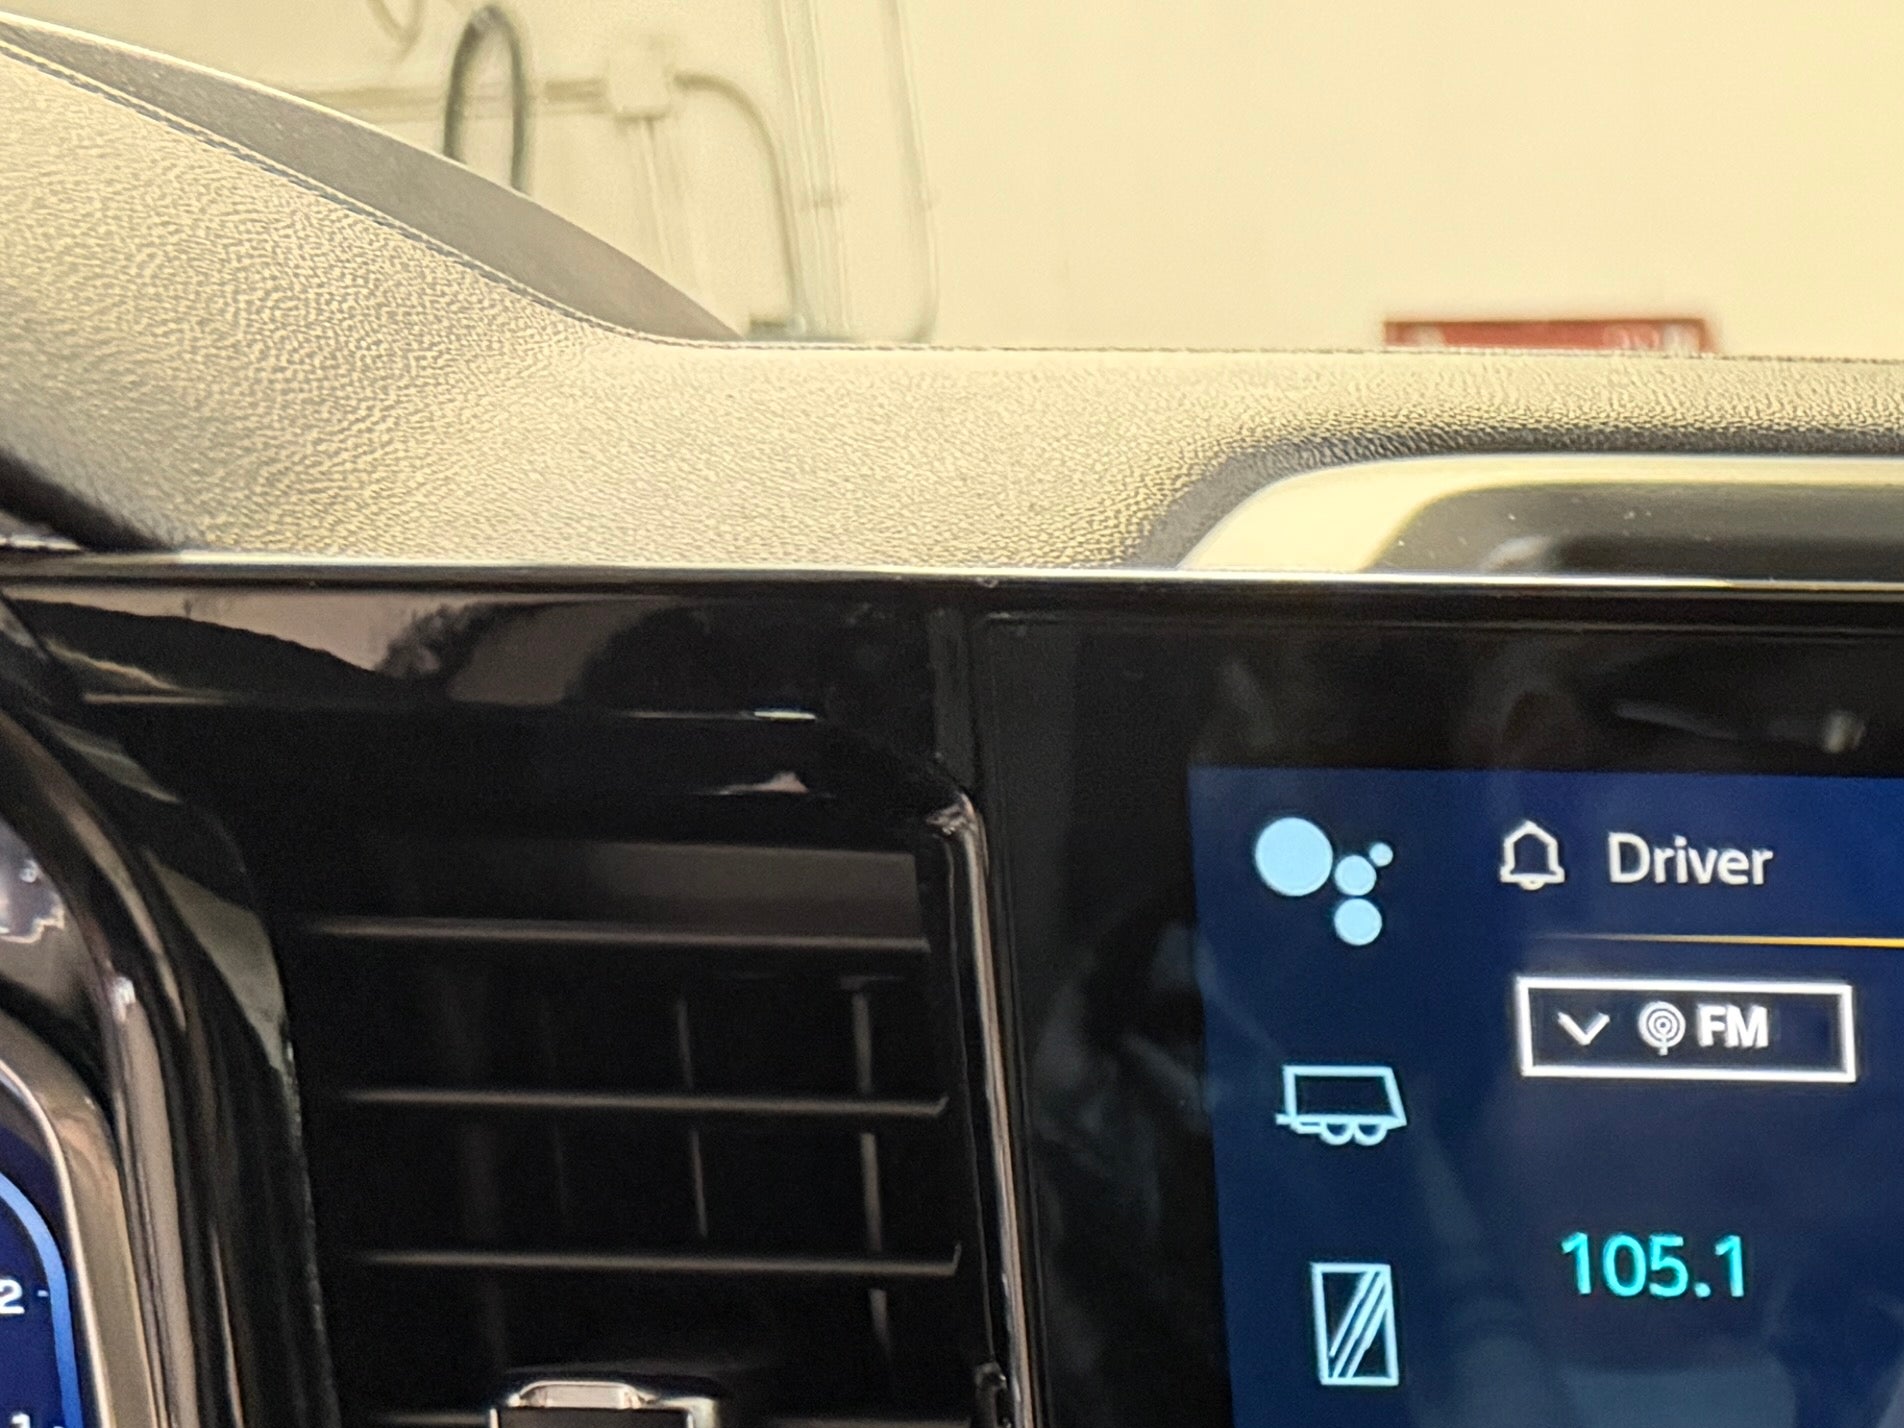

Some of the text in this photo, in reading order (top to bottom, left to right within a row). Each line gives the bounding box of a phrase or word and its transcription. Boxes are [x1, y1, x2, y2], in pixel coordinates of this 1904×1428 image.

[1607, 831, 1774, 886] Driver
[1695, 1002, 1770, 1049] FM
[1561, 1231, 1745, 1298] 105.1
